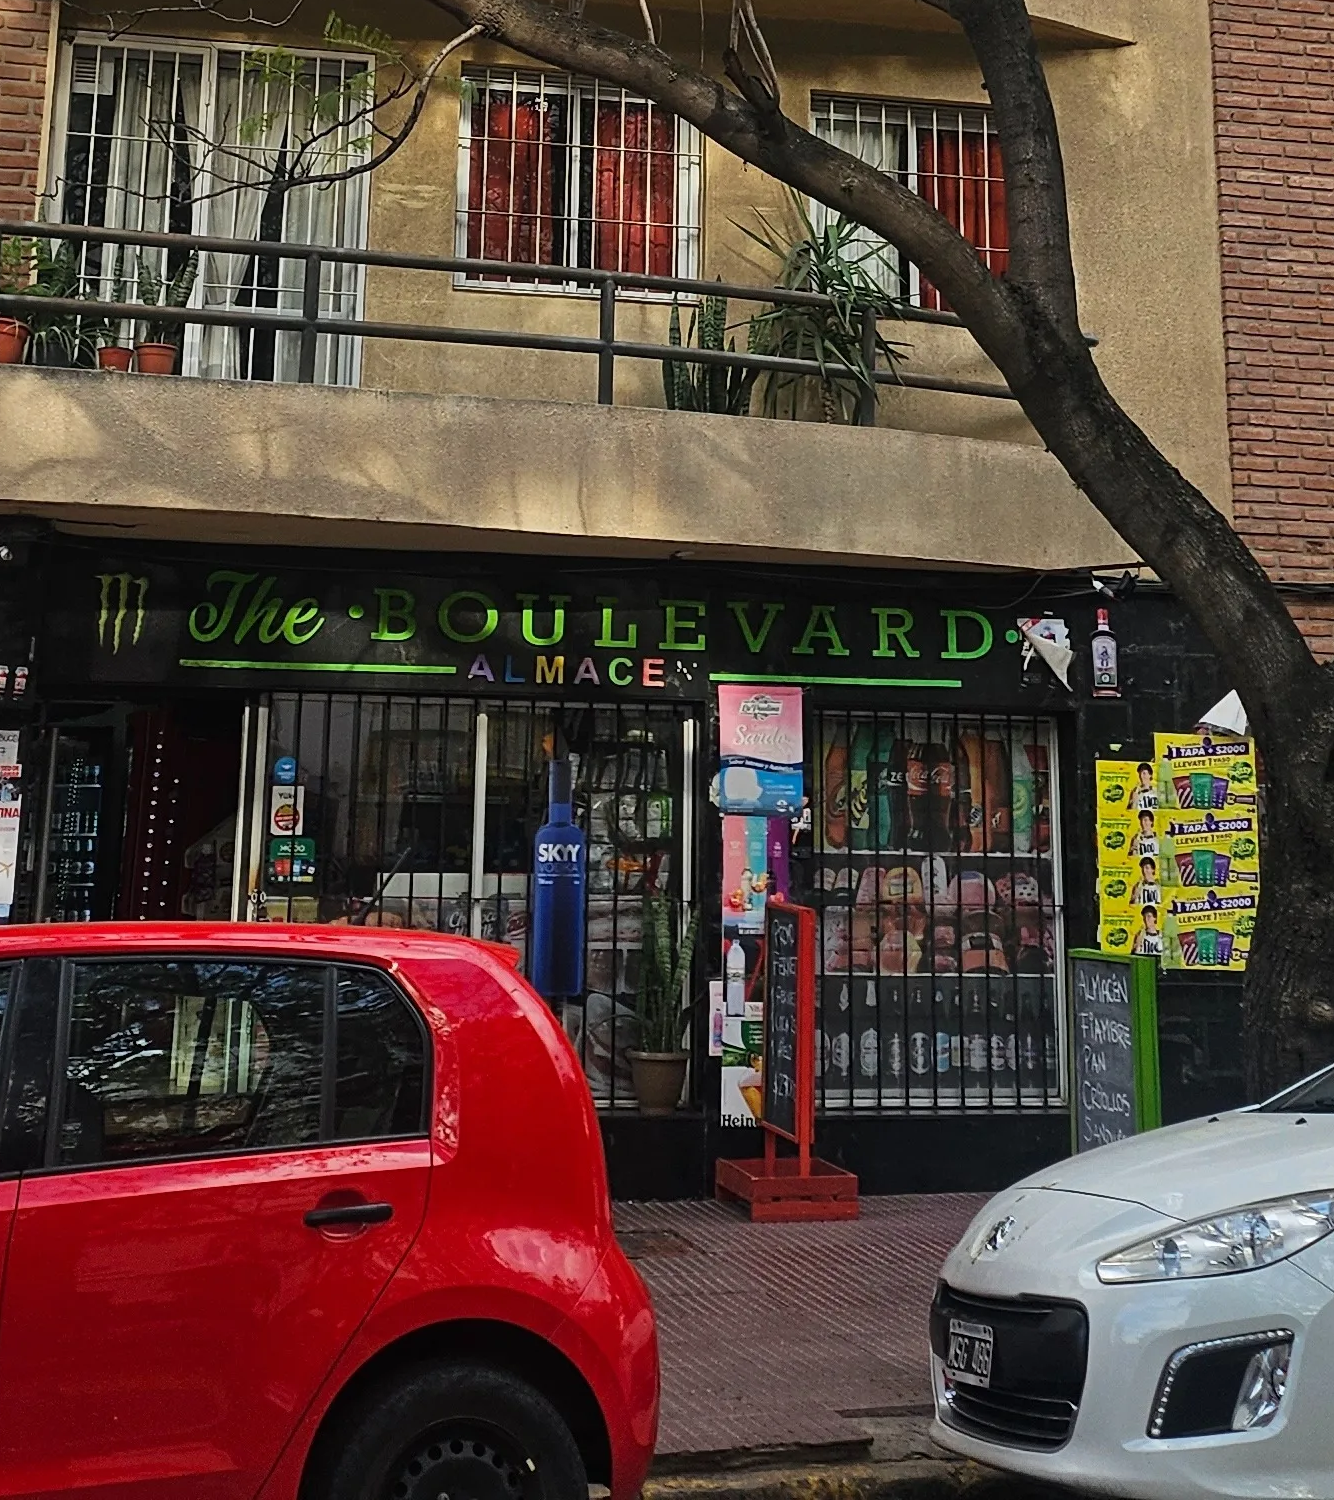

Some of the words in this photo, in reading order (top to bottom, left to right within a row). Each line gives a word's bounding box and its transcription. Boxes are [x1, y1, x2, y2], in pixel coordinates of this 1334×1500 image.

[188, 569, 326, 645] The
[370, 586, 993, 660] BOULEVARD
[1180, 746, 1206, 756] TAPA
[1216, 745, 1246, 754] $2000
[1174, 759, 1206, 768] LLEVATE
[1183, 823, 1208, 833] TAPA
[1219, 821, 1248, 831] $2000
[1176, 836, 1209, 845] LLEVATE
[538, 843, 581, 862] SKYY
[1185, 901, 1211, 911] TAPA
[1222, 898, 1251, 908] $2000
[1178, 915, 1211, 924] LLEVATE
[1078, 969, 1129, 1003] ALMACÉN
[1084, 1045, 1106, 1074] PAN
[721, 1114, 757, 1128] Hein
